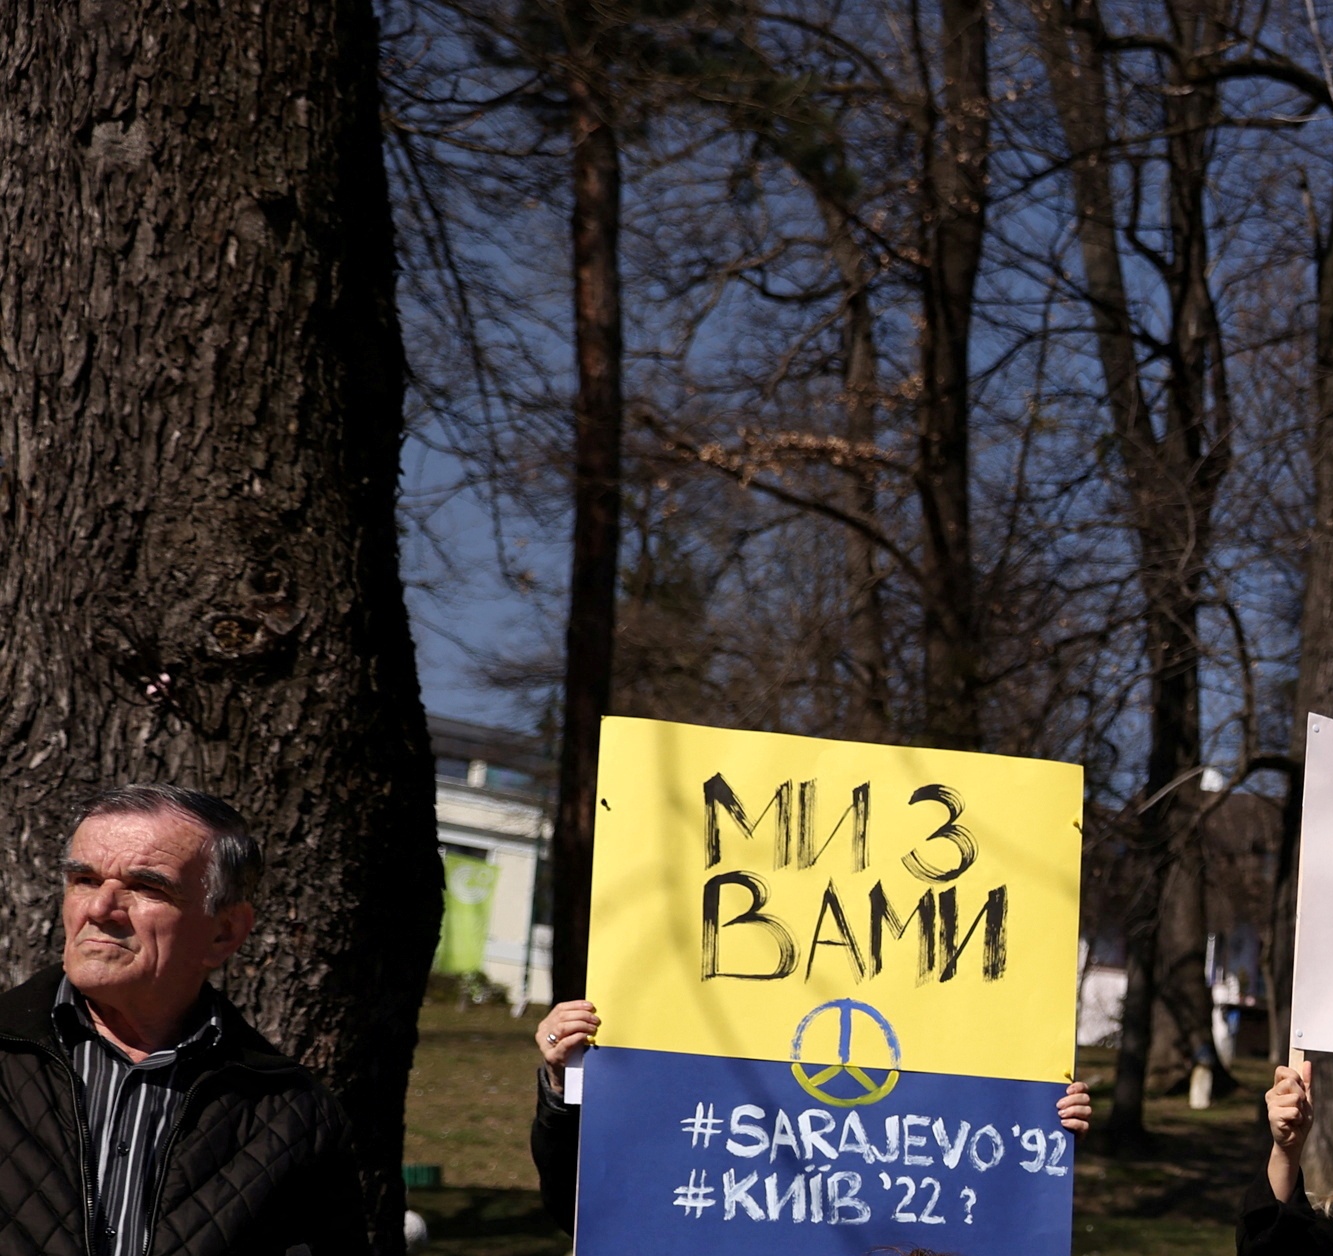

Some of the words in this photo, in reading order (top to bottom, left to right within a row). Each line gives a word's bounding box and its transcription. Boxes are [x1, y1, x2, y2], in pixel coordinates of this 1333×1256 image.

[703, 772, 871, 871] МИ
[701, 871, 1008, 985] ВАМИ
[680, 1102, 1005, 1172] #SARAJEVO
